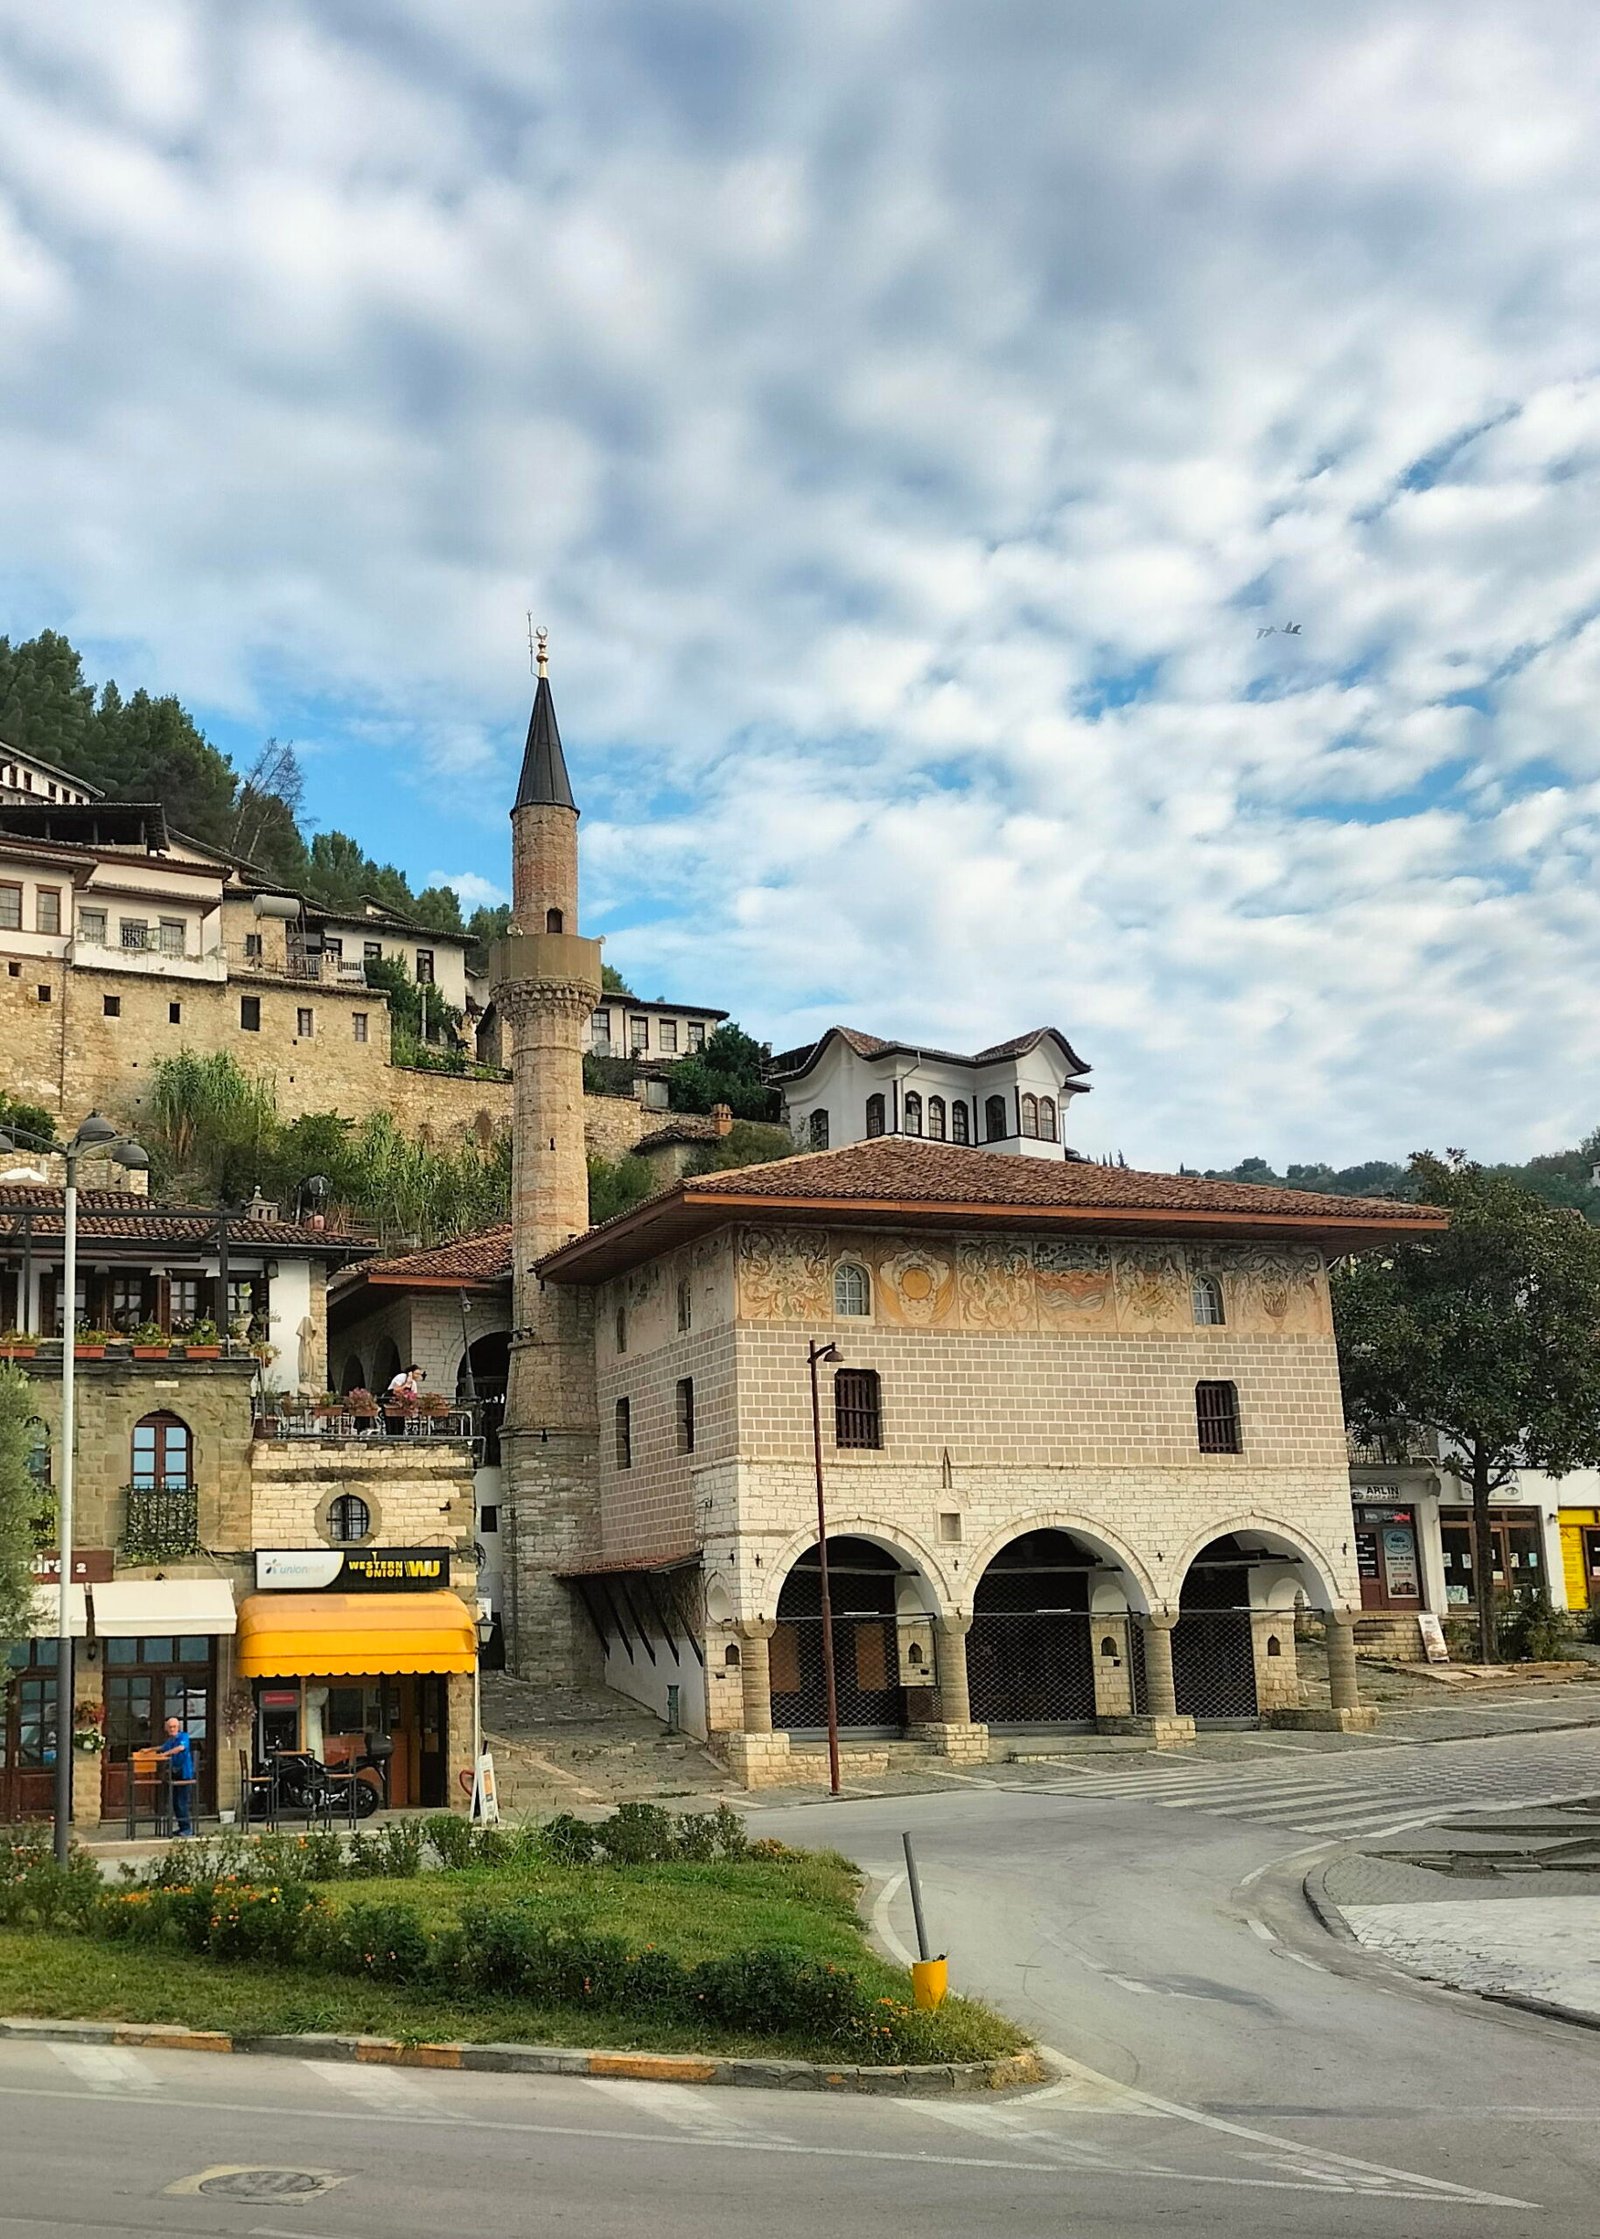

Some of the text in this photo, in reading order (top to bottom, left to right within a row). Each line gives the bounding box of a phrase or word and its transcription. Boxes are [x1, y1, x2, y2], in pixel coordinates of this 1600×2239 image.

[1366, 1486, 1399, 1495] ARLIN
[76, 1563, 87, 1573] 2
[349, 1561, 403, 1570] WESTERN
[407, 1561, 440, 1577] WU
[365, 1569, 403, 1578] UNION
